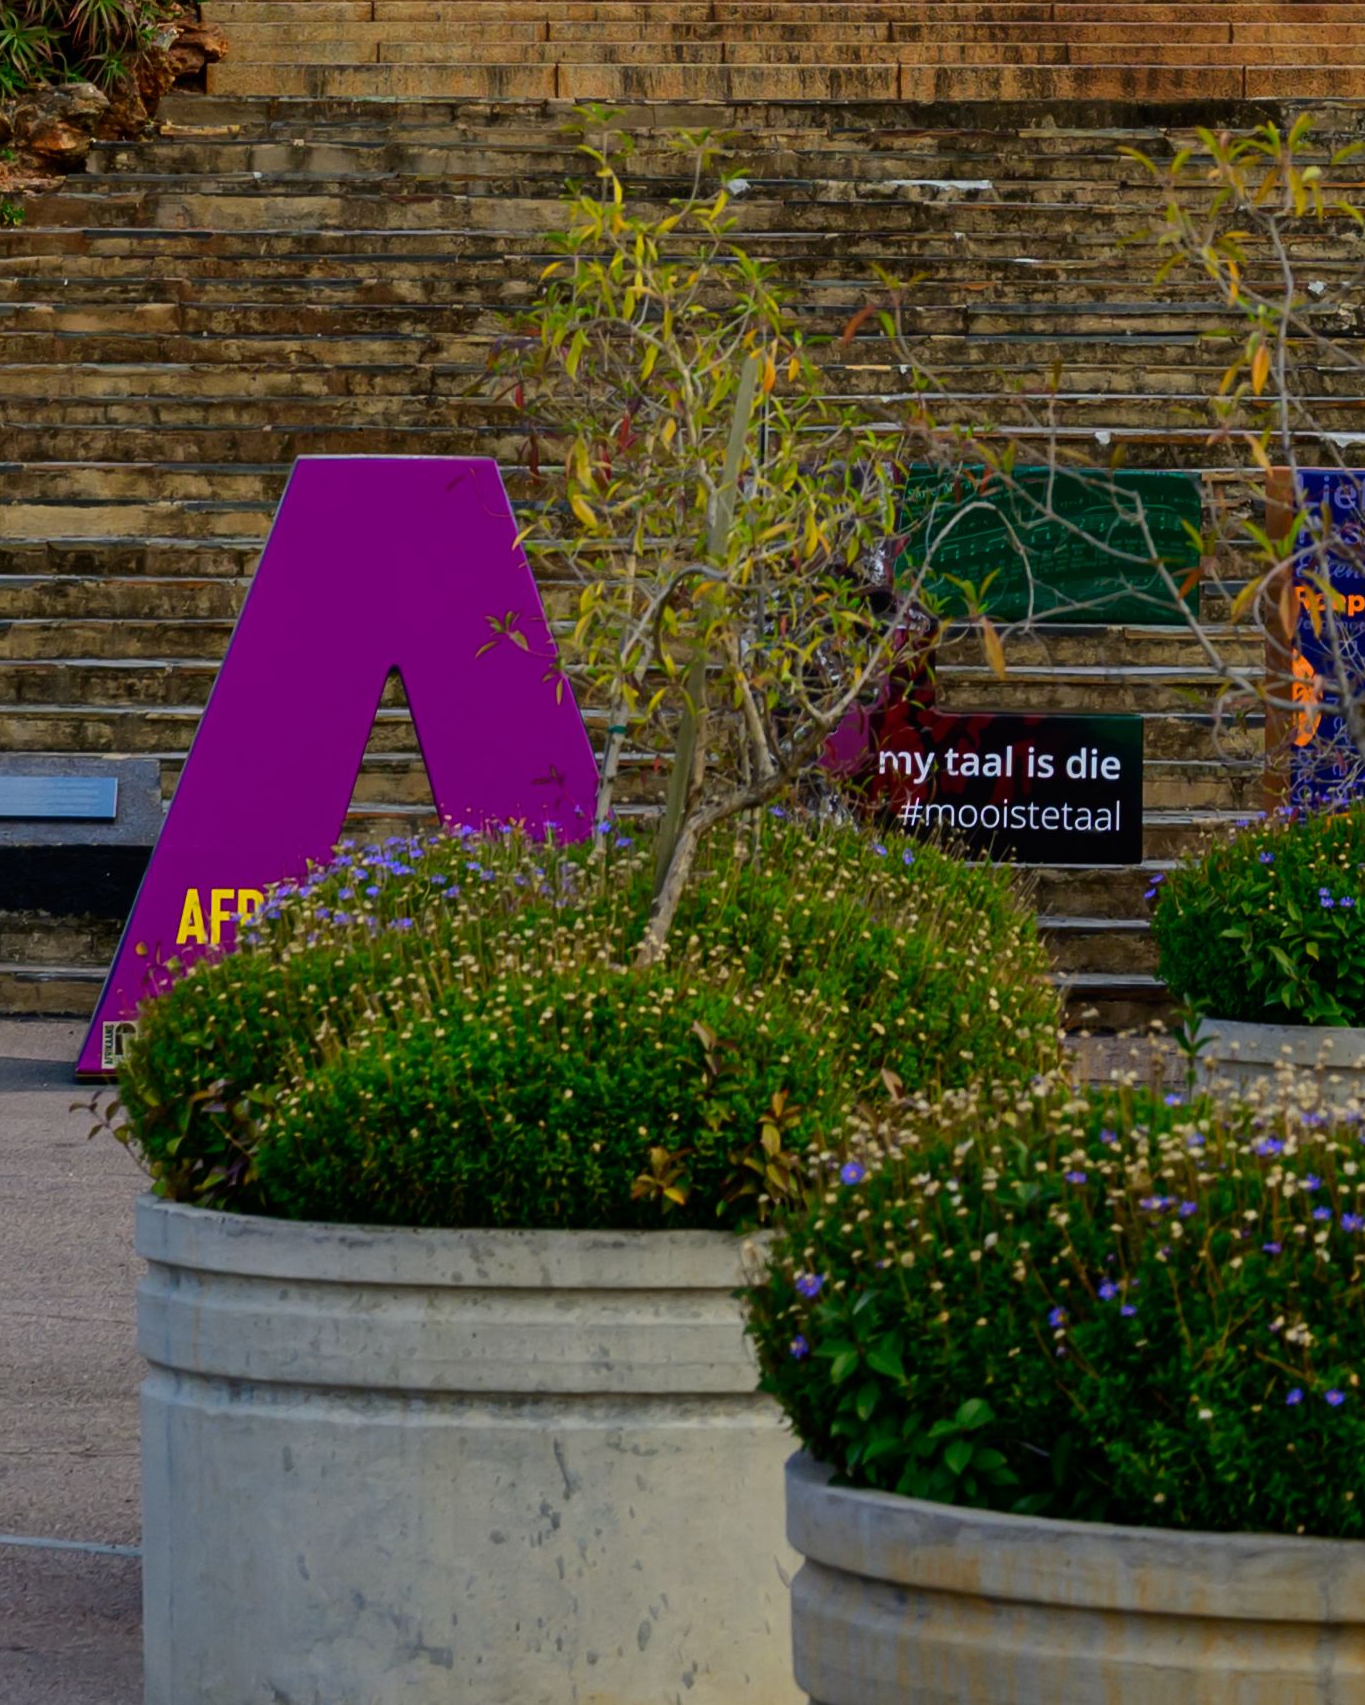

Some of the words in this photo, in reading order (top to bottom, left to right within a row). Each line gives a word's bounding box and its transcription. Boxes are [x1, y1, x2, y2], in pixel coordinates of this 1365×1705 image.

[879, 749, 935, 784] my
[945, 745, 1013, 777] taal
[1028, 747, 1054, 778] is
[1066, 747, 1121, 780] die
[900, 797, 1121, 832] #mooistetaal
